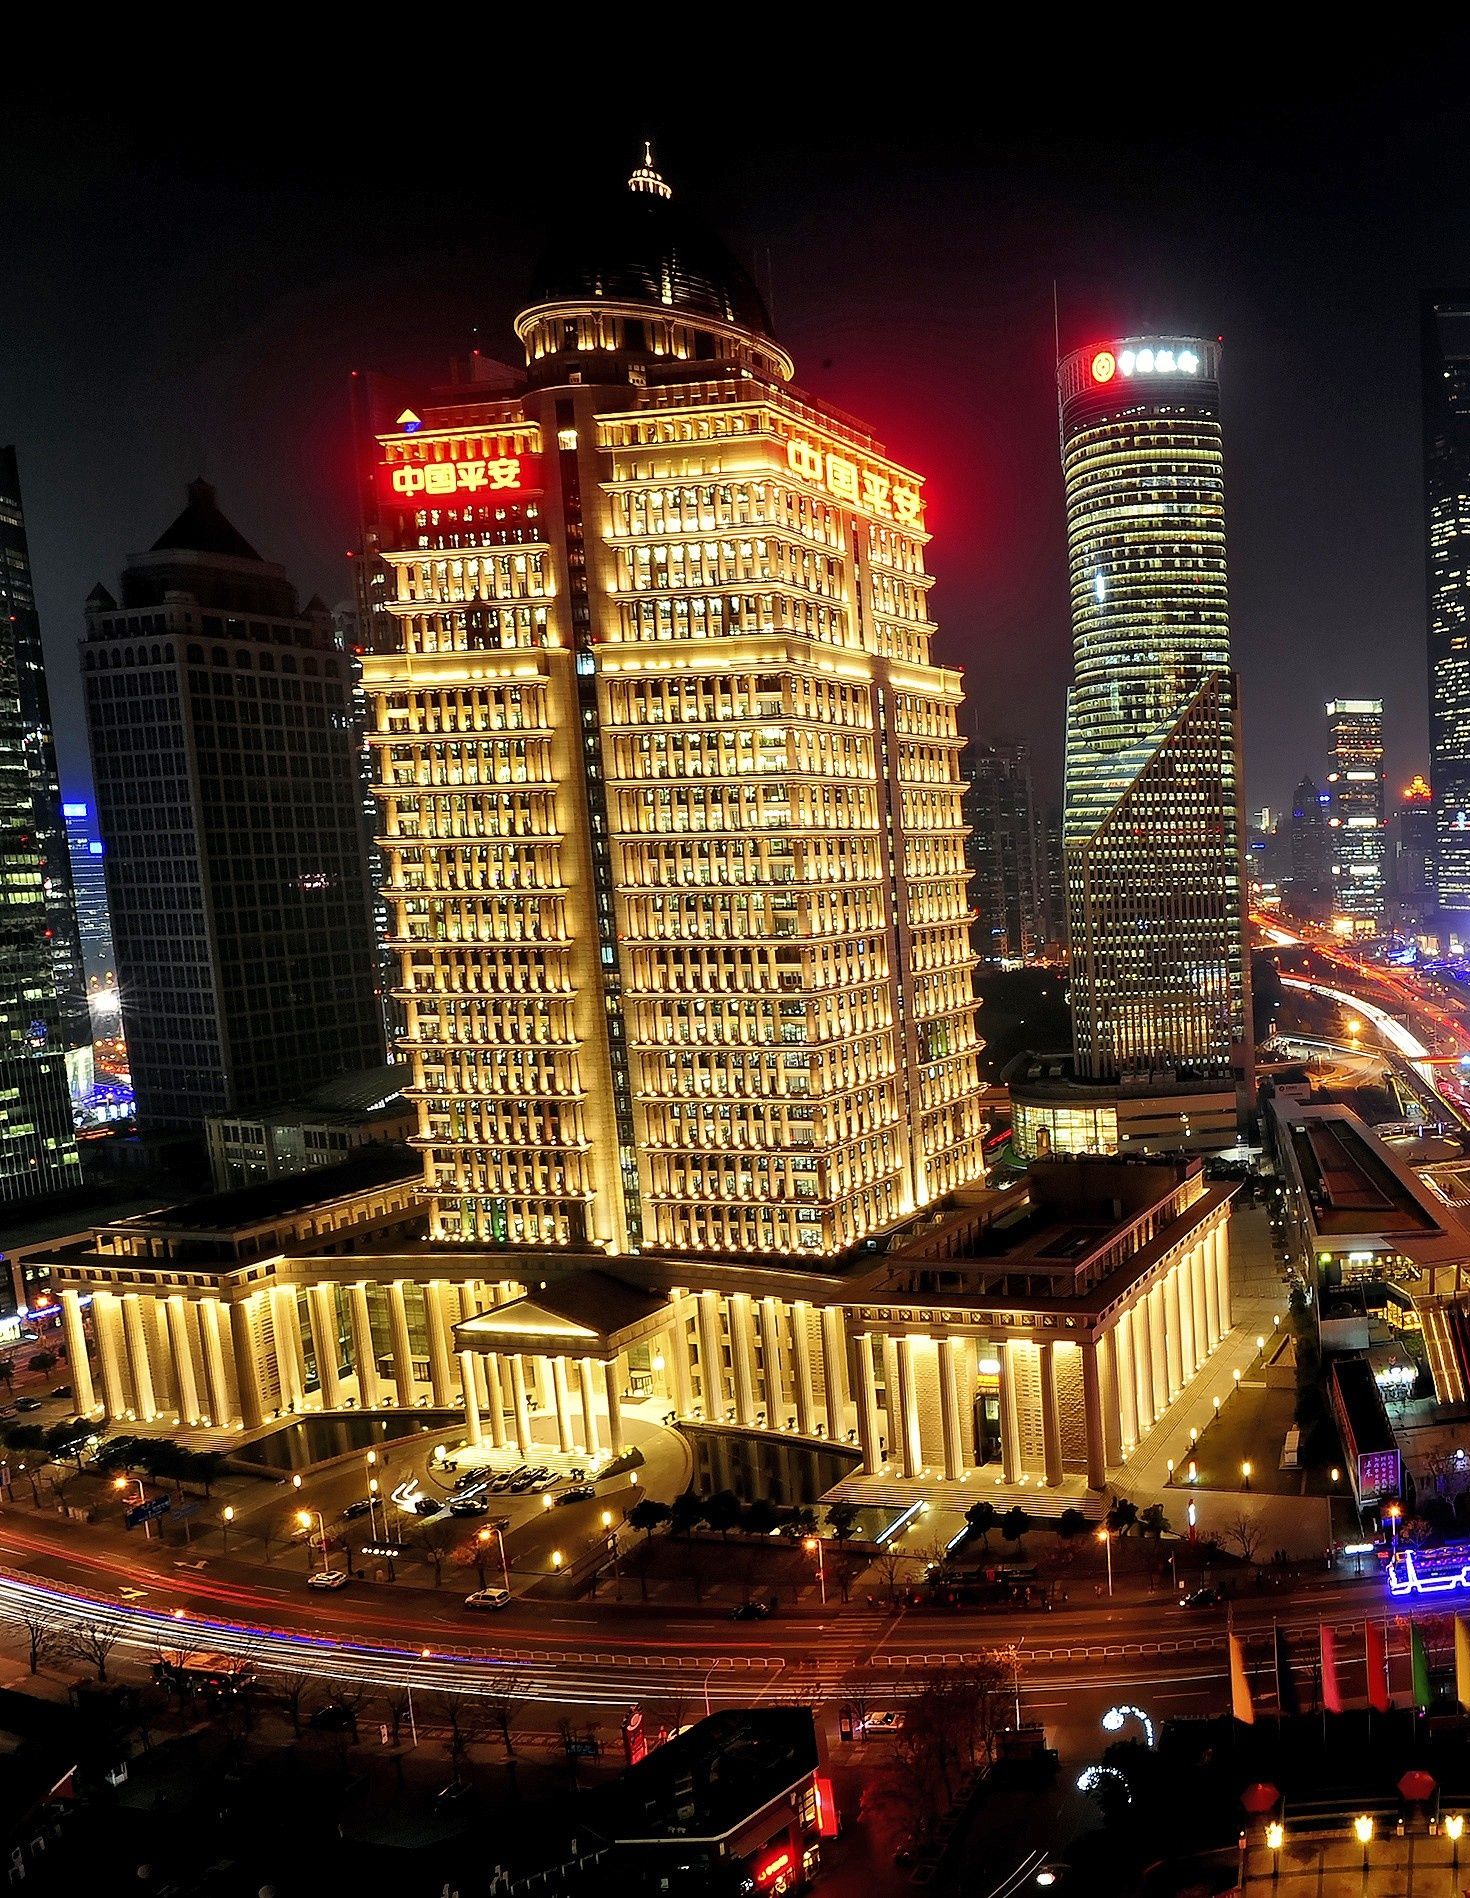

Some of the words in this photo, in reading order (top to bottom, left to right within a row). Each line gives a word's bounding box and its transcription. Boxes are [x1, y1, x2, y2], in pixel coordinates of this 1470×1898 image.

[393, 458, 521, 497] 中国平安
[787, 438, 922, 528] 中国平安
